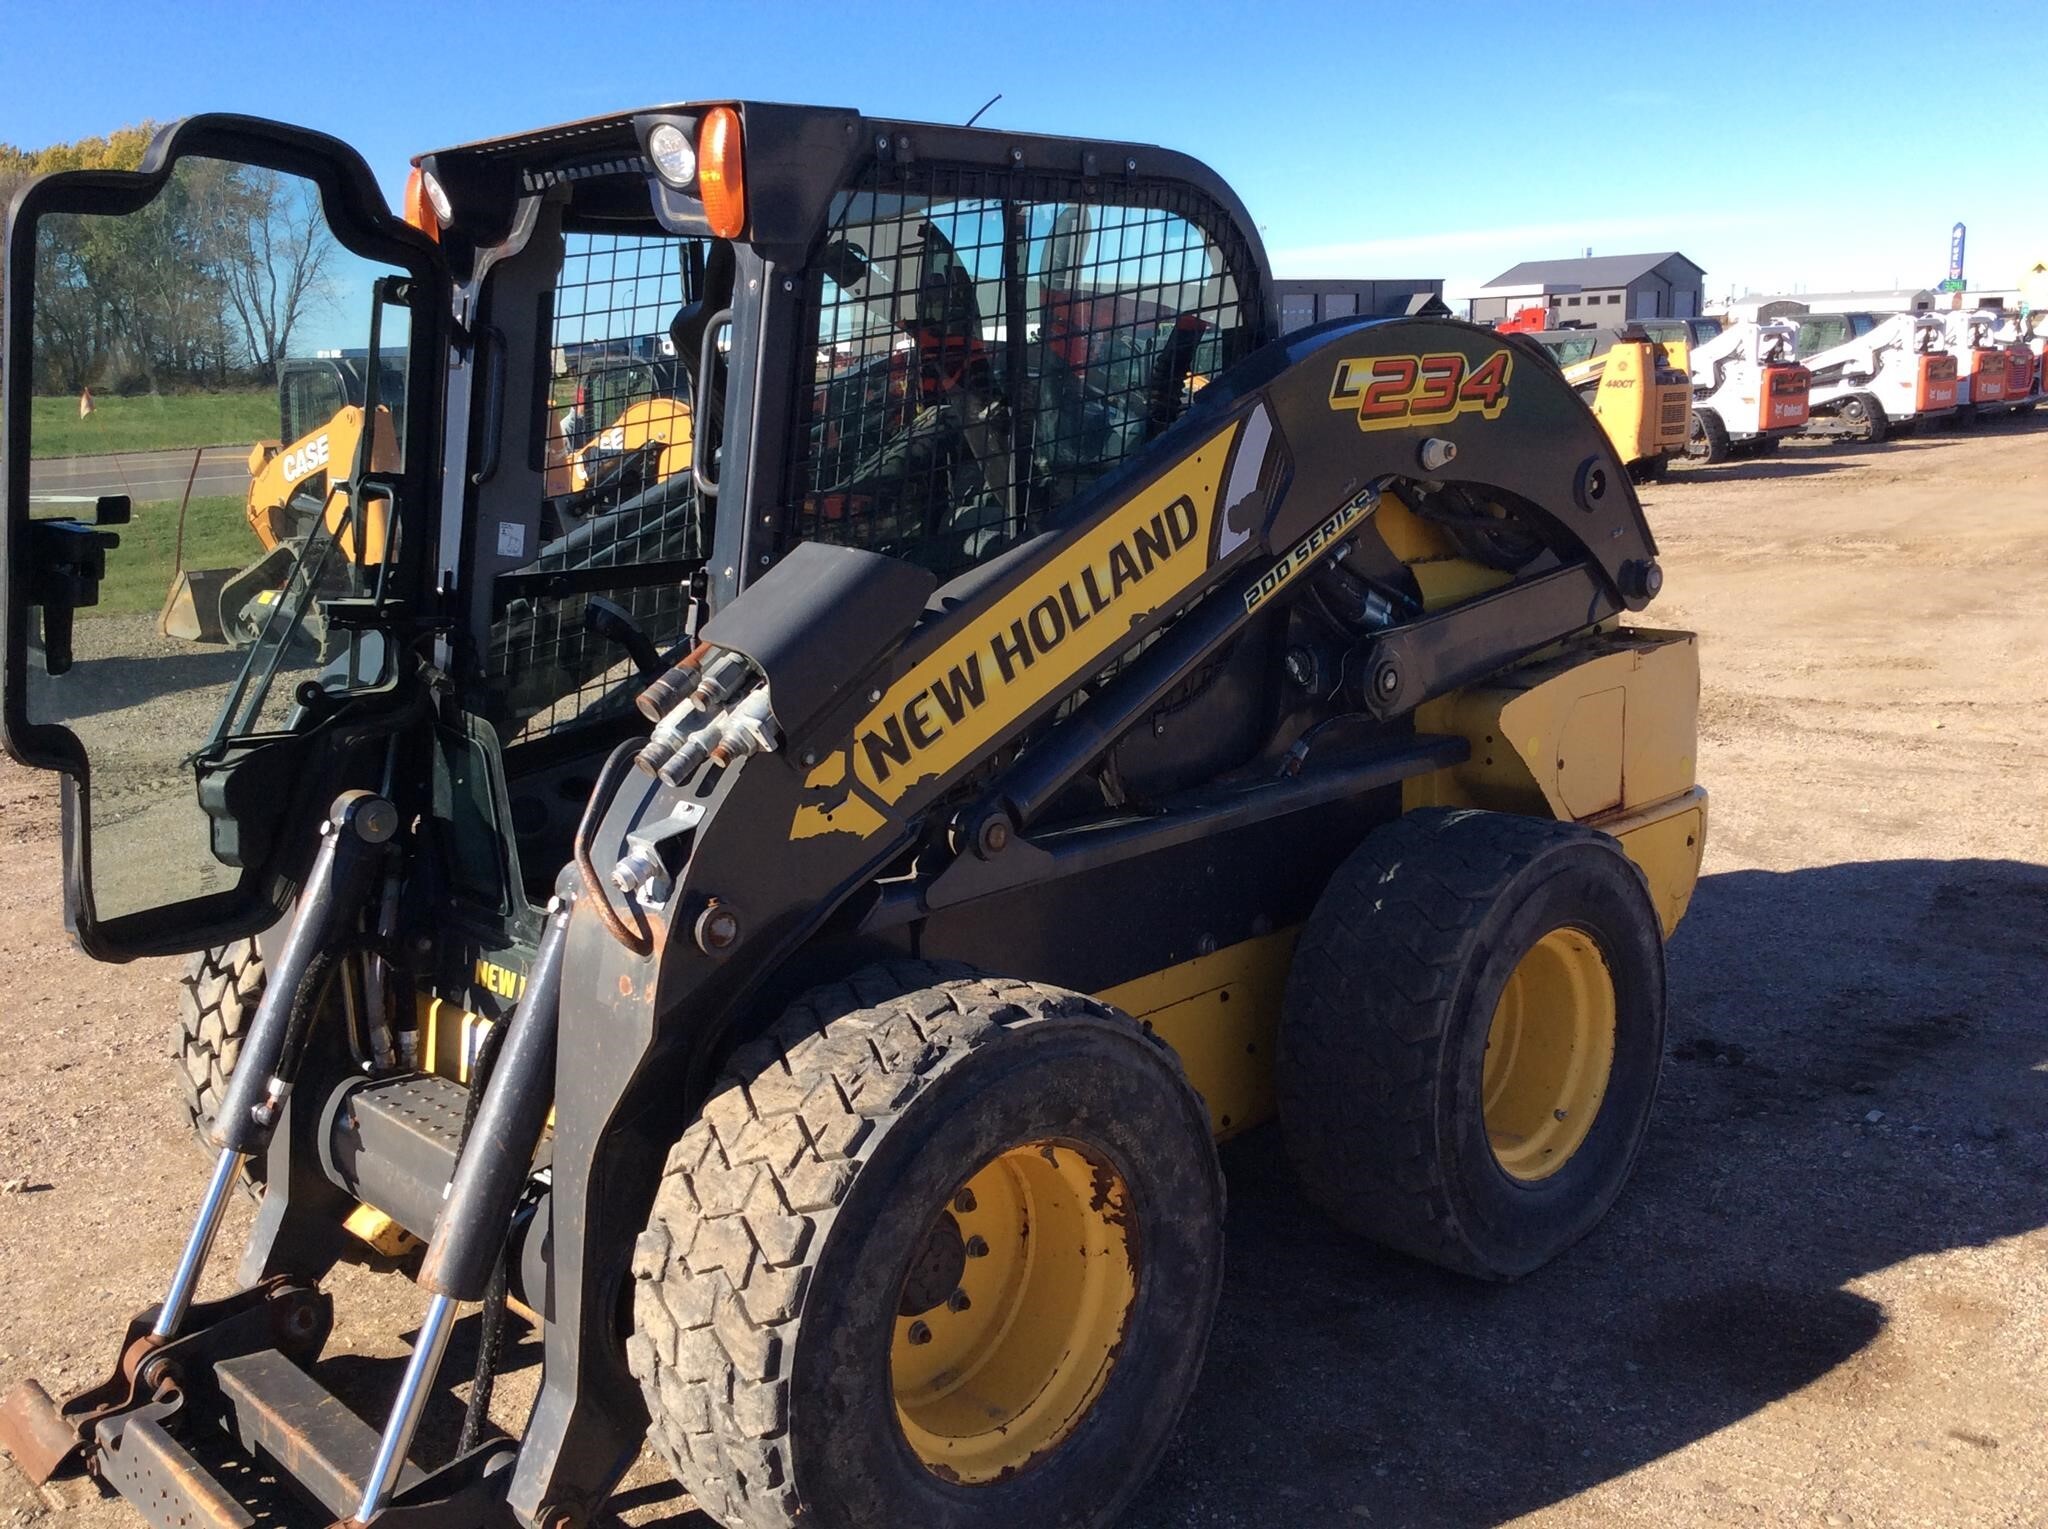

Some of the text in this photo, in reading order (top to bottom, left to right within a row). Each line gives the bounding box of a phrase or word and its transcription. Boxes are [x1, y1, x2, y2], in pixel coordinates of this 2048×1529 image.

[1330, 352, 1511, 427] L234
[1605, 379, 1636, 389] 440CT
[1783, 402, 1805, 417] Bobcat
[283, 433, 329, 482] CASE
[1245, 489, 1372, 610] 200 SERIES
[860, 493, 1199, 785] NEW HOLLAND
[475, 959, 517, 1000] NEW
